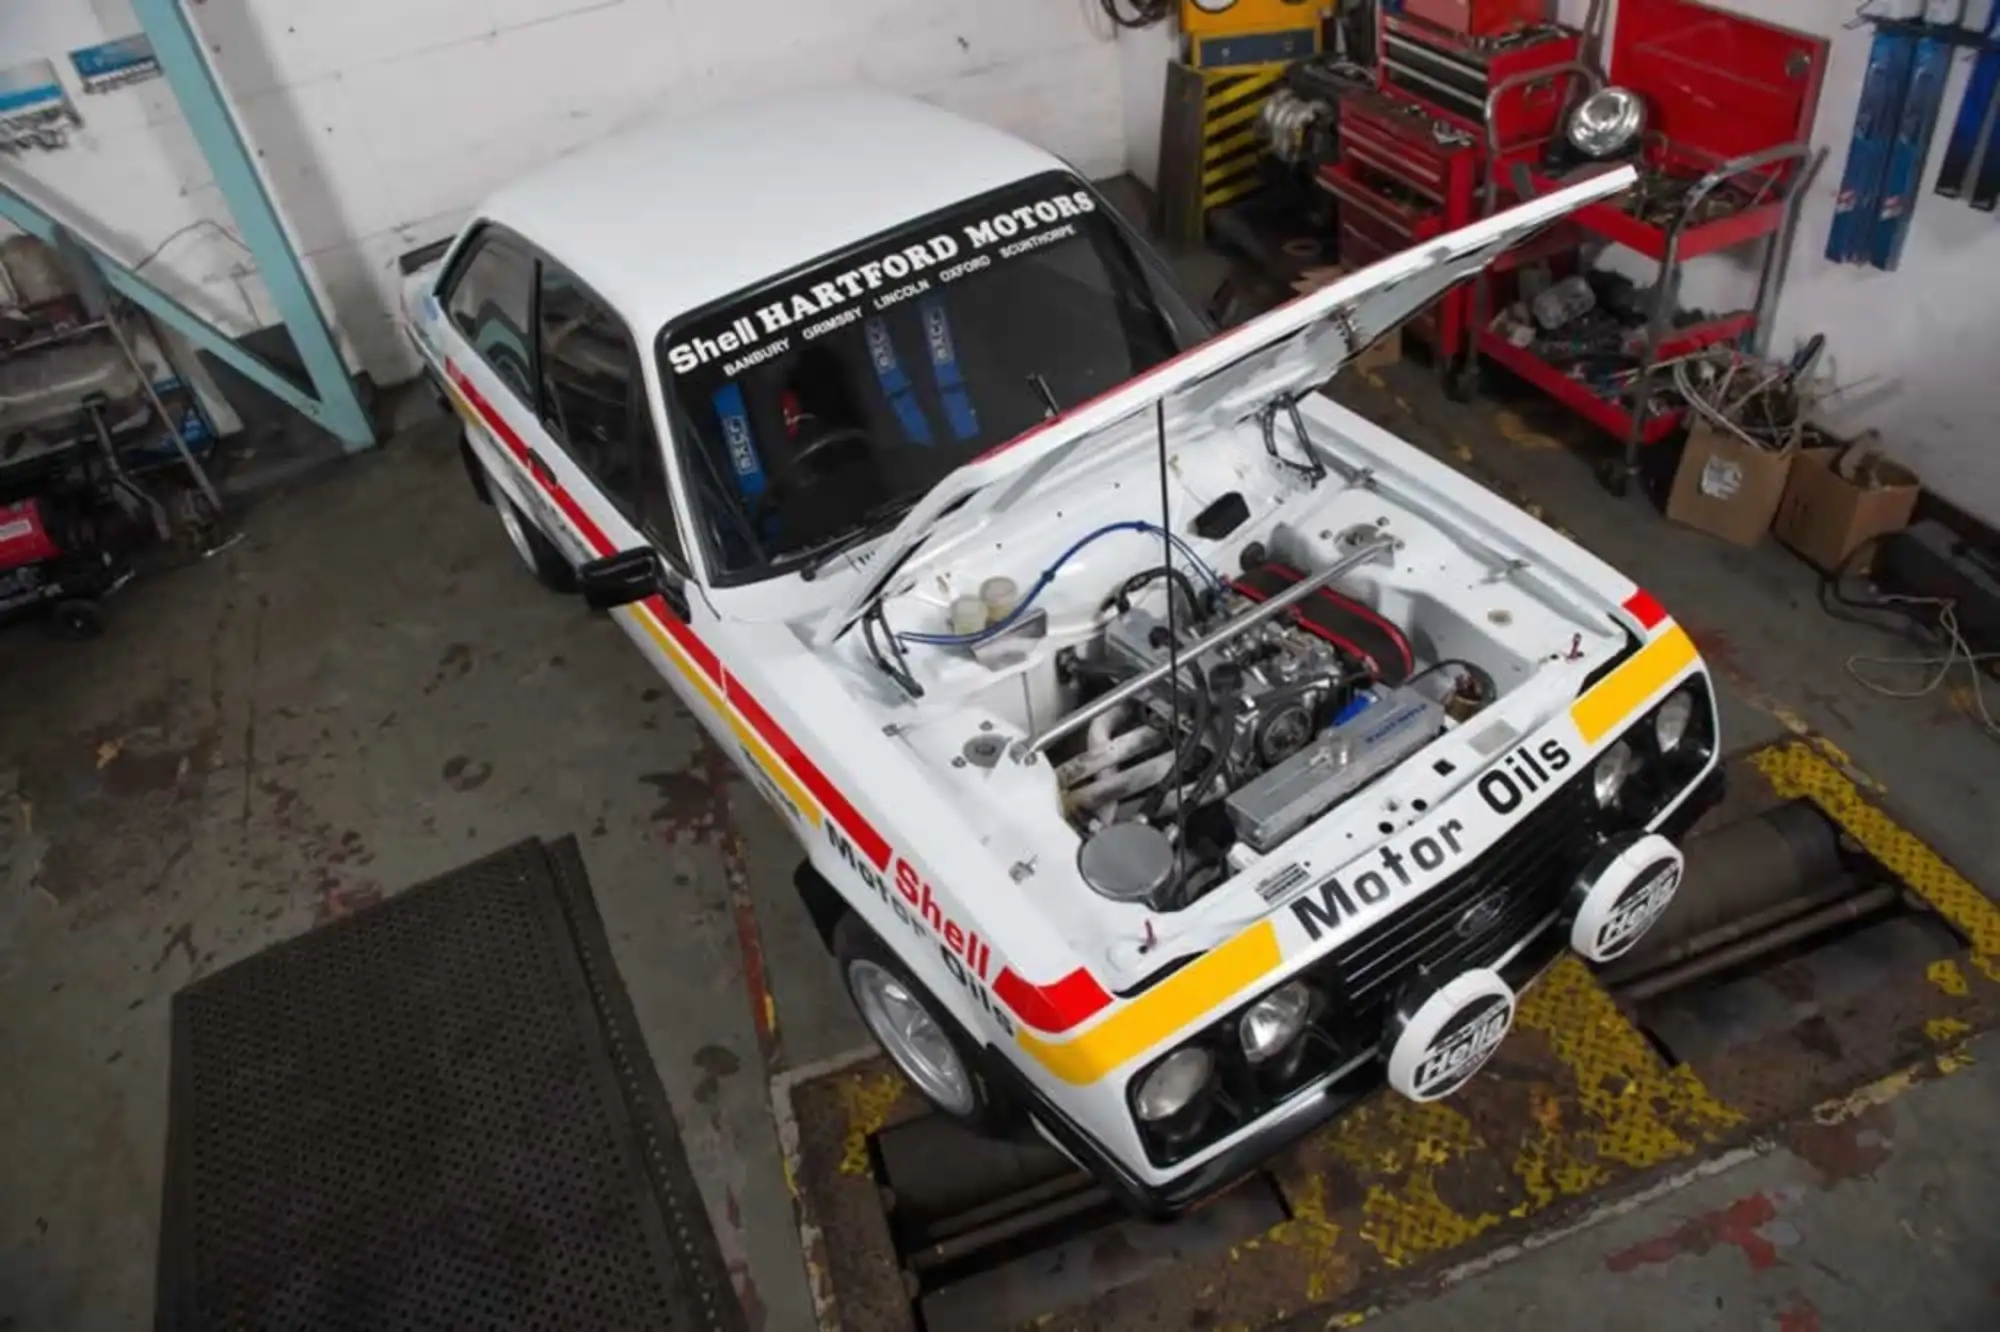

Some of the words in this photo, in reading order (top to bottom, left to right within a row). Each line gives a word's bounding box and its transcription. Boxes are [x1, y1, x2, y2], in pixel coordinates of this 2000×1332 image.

[668, 316, 759, 374] Shell
[756, 234, 959, 334] HARTFORD
[963, 191, 1095, 249] MOTORS
[722, 336, 790, 377] BANBURY
[802, 306, 864, 340] GRIMSBY
[872, 278, 931, 310] LINCOLN
[938, 254, 991, 282] OXFORD
[998, 223, 1077, 258] SCUNTHORPE
[895, 857, 991, 981] Shell
[1290, 815, 1463, 941] Motor
[1476, 735, 1571, 815] Oils
[823, 817, 927, 938] Motor
[939, 944, 1014, 1038] Oils
[1421, 1012, 1506, 1086] Hella
